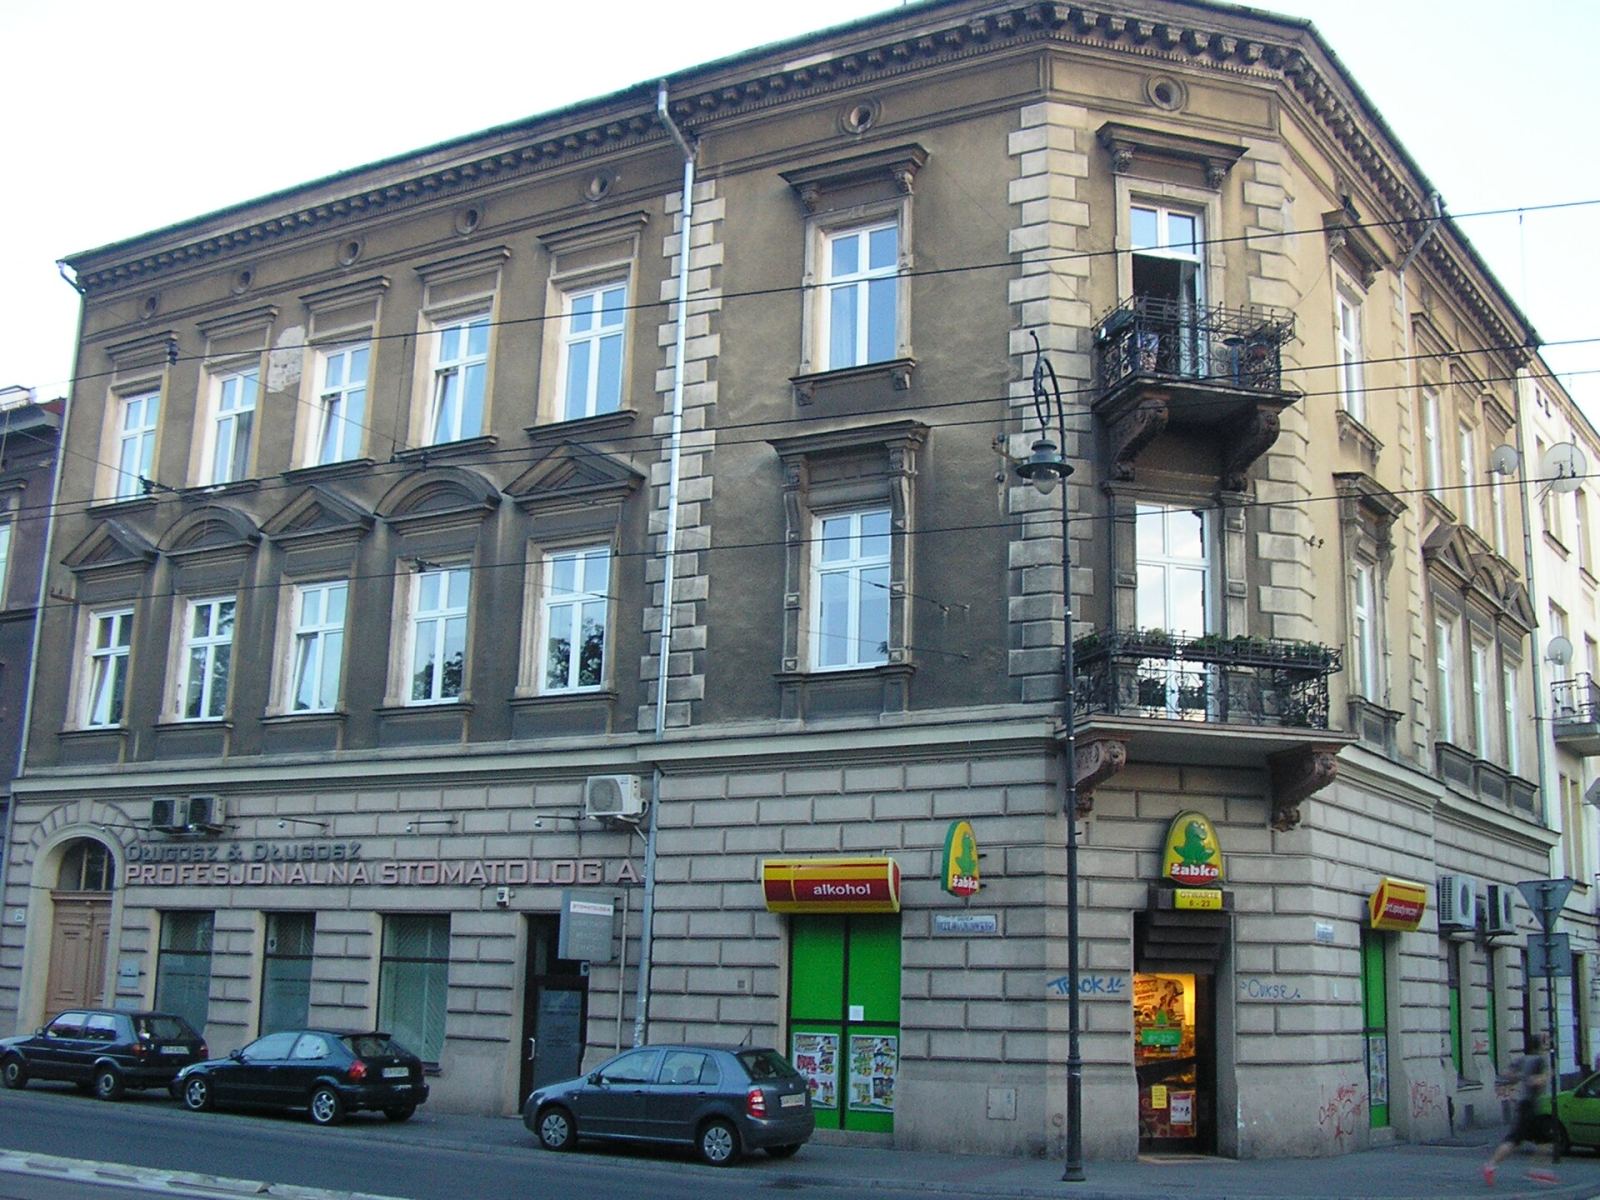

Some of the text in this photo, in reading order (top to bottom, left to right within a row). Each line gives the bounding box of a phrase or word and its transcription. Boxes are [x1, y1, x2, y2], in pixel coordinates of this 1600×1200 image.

[229, 842, 242, 861] &
[125, 862, 371, 885] PROFESJONALNA
[1171, 863, 1219, 877] żabka
[813, 883, 871, 896] alkohol
